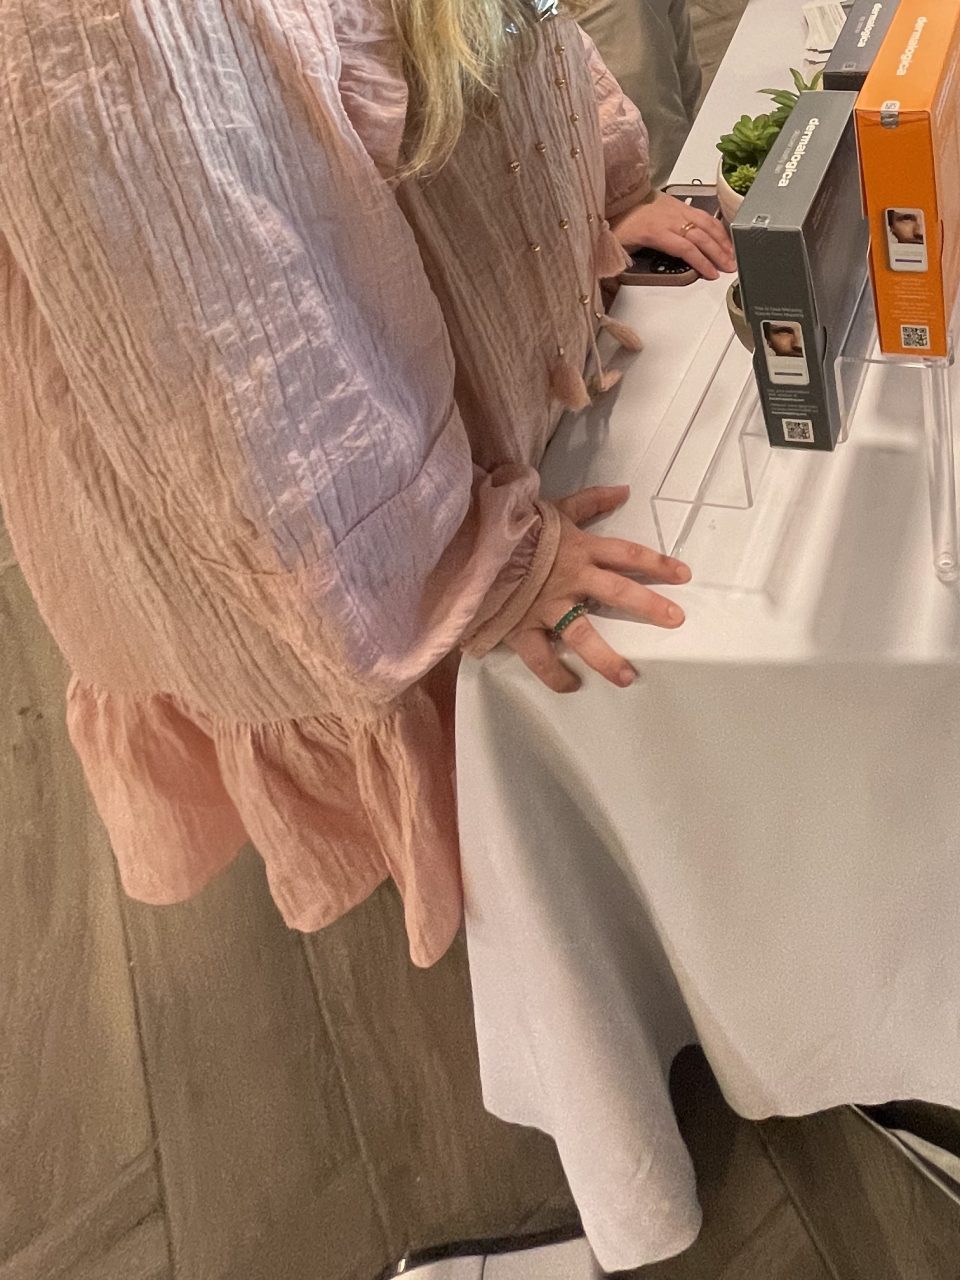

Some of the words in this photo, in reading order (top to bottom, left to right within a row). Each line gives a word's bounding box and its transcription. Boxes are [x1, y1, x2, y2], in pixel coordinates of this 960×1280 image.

[857, 3, 882, 47] dermalogica
[896, 16, 928, 76] dermalogica
[777, 118, 820, 187] dermalogica
